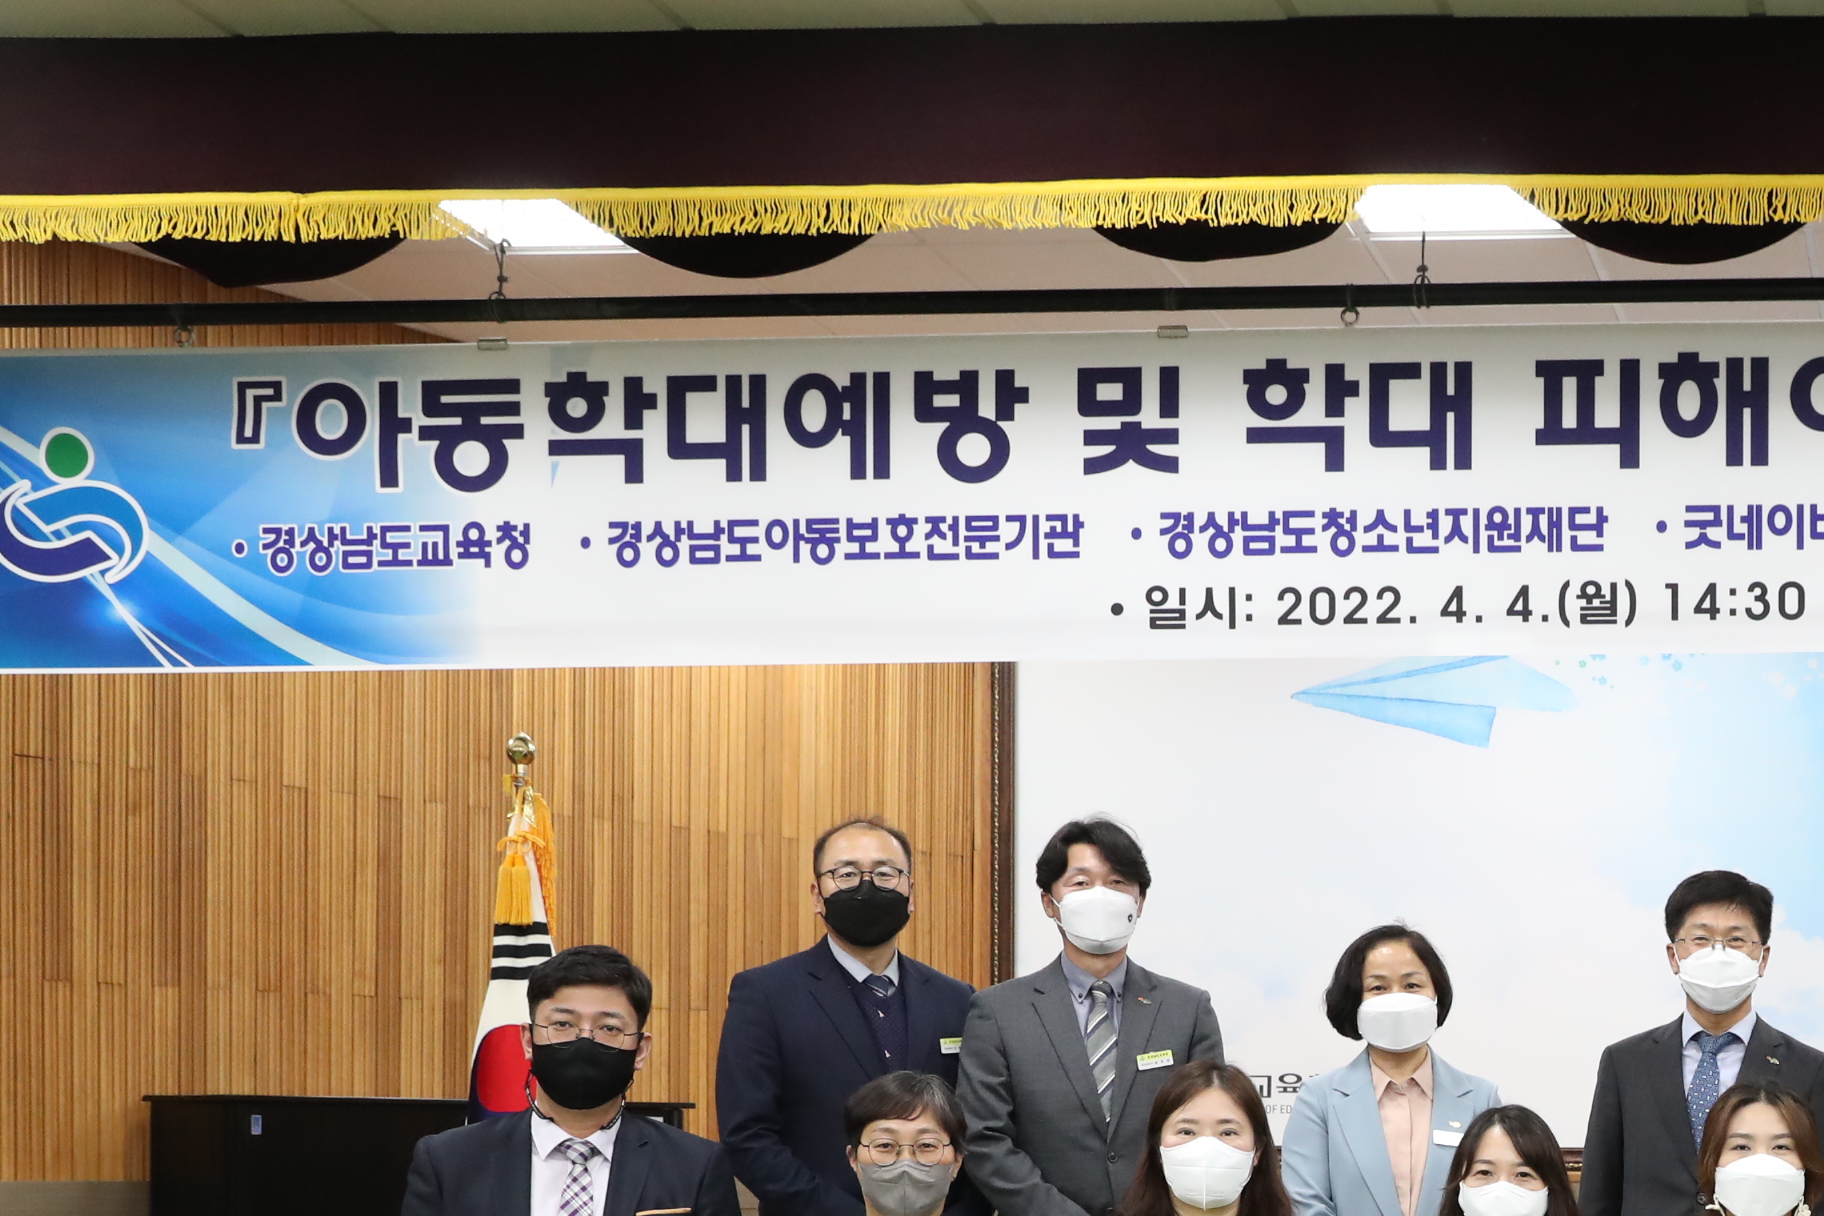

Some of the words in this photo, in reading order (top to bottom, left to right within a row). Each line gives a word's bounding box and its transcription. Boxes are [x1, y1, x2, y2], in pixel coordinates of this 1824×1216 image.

[233, 365, 1030, 492] 『아동학대예방
[1077, 366, 1180, 475] 및
[1243, 359, 1473, 471] 학대
[263, 522, 531, 573] 경상남도교육청
[608, 514, 1085, 567] 경상남도아동보호전문기관
[1159, 507, 1609, 558] 경상남도청소년지원재단
[1145, 586, 1253, 629] 일시:
[1277, 587, 1417, 626] 2022.
[1441, 586, 1483, 623] 4.
[1665, 581, 1805, 621] 14:30
